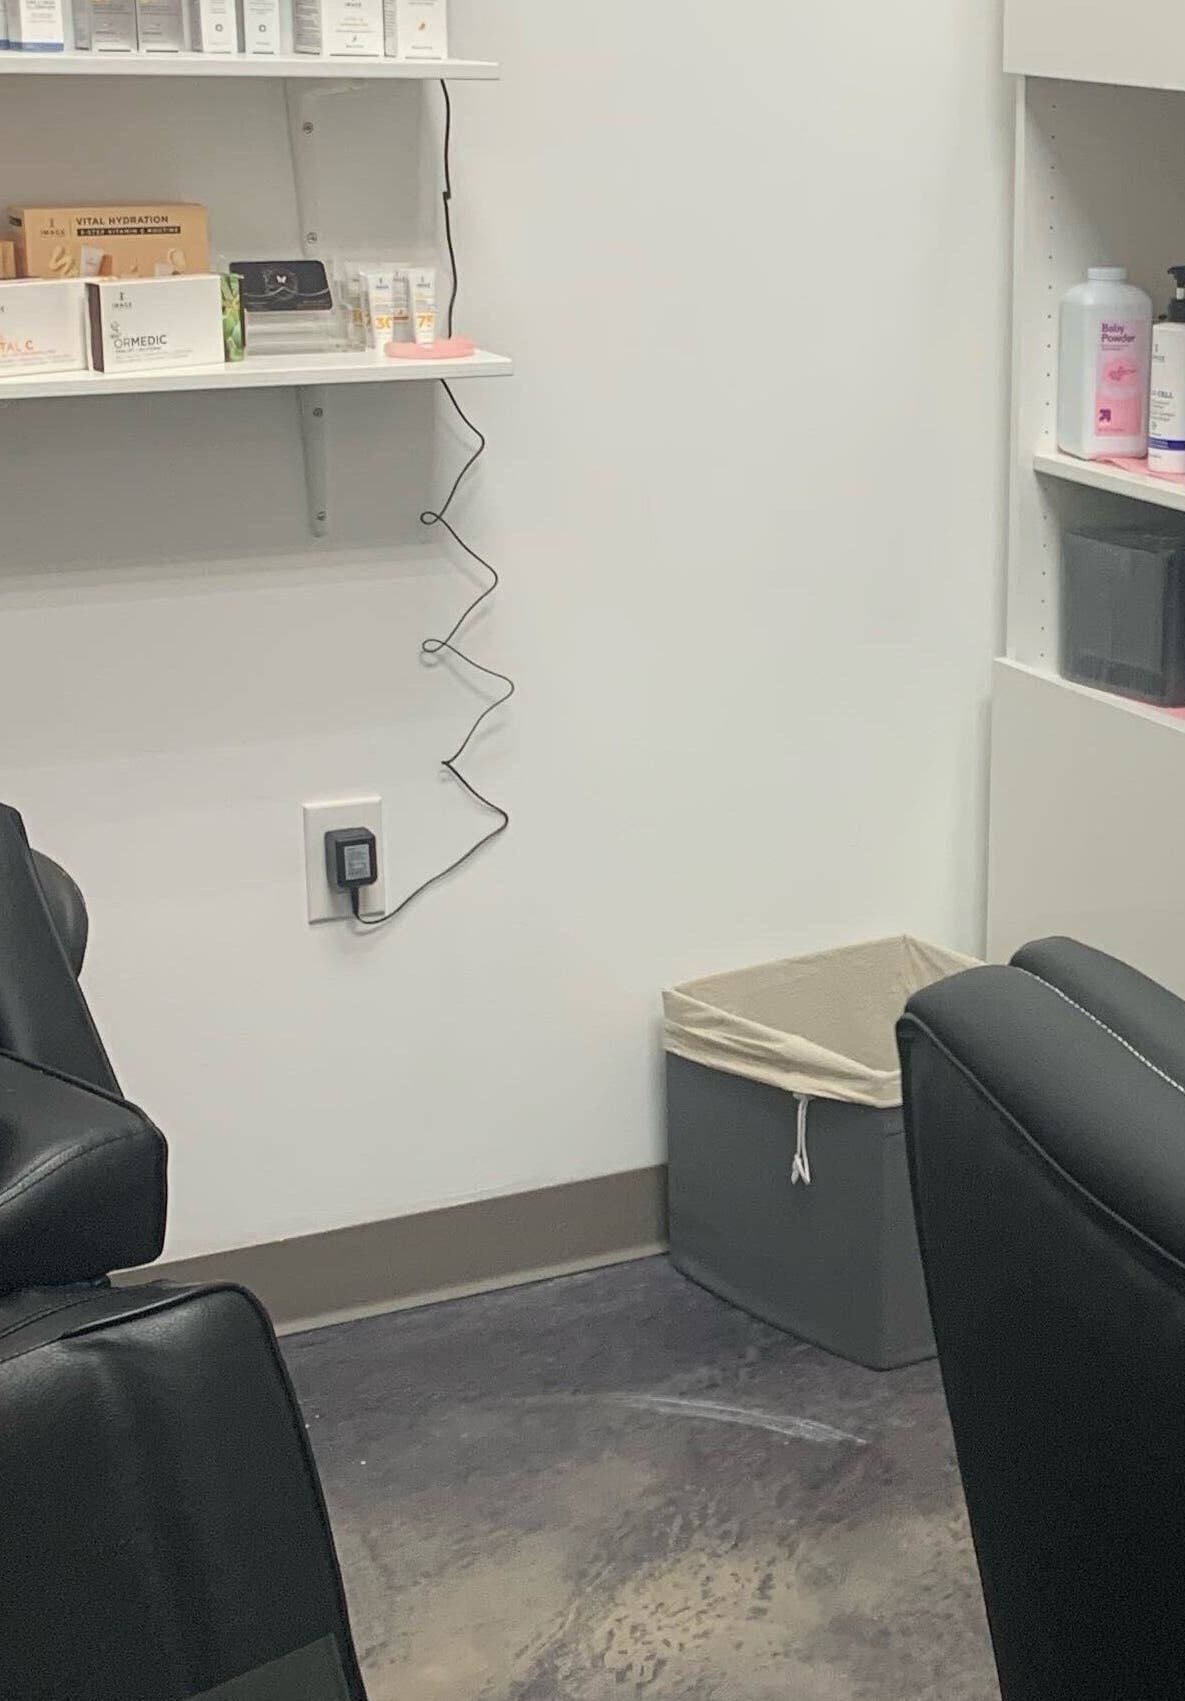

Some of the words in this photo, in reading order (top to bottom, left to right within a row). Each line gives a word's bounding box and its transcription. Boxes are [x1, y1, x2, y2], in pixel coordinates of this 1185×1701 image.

[76, 216, 105, 226] VITAL
[108, 214, 169, 225] HYDRATION
[1101, 323, 1124, 335] Baby
[113, 334, 168, 349] ORMEDIC
[1101, 333, 1136, 343] Powder
[25, 340, 34, 350] C
